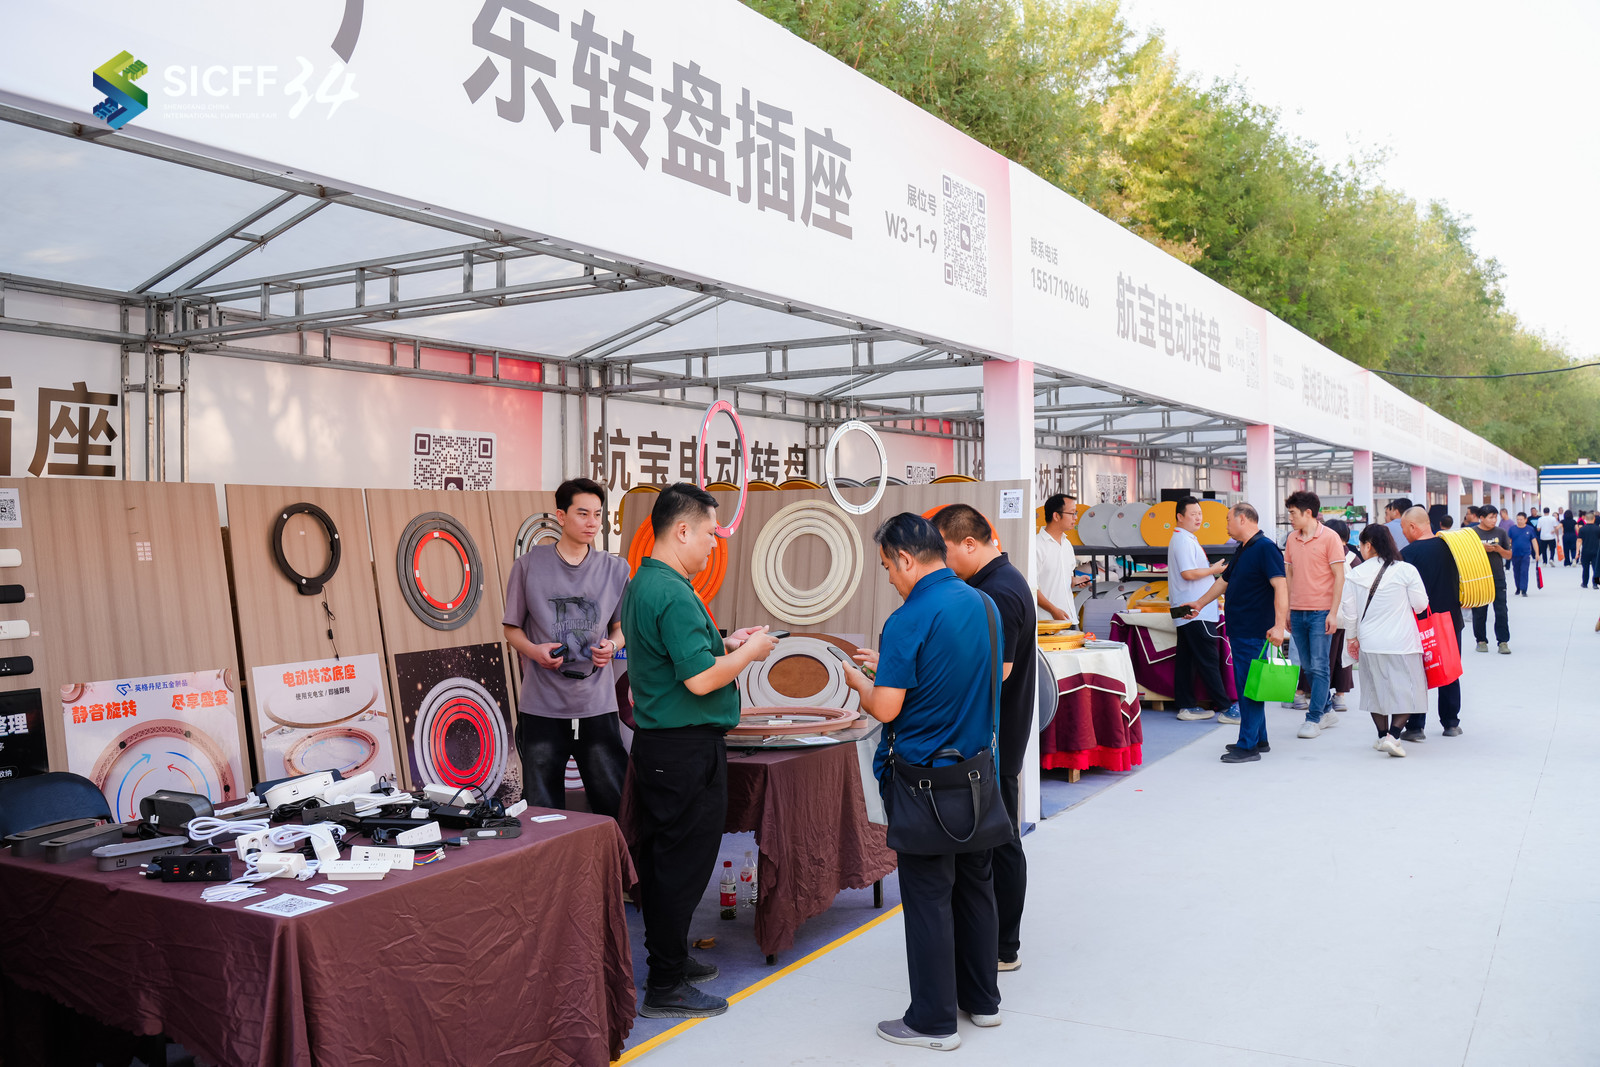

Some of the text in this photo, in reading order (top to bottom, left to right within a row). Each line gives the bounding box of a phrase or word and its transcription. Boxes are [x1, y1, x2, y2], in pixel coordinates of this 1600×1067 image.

[331, 0, 854, 240] 乐转盘插座
[907, 183, 937, 217] 展位号
[885, 210, 938, 254] W3-1-9
[1030, 236, 1058, 266] 联系电话
[1030, 266, 1090, 309] 15517196166
[1116, 271, 1222, 373] 航宝电动转盘
[282, 664, 356, 687] 电动转芯底座
[71, 699, 137, 724] 静音旋转
[171, 689, 228, 711] 尽享盛宴
